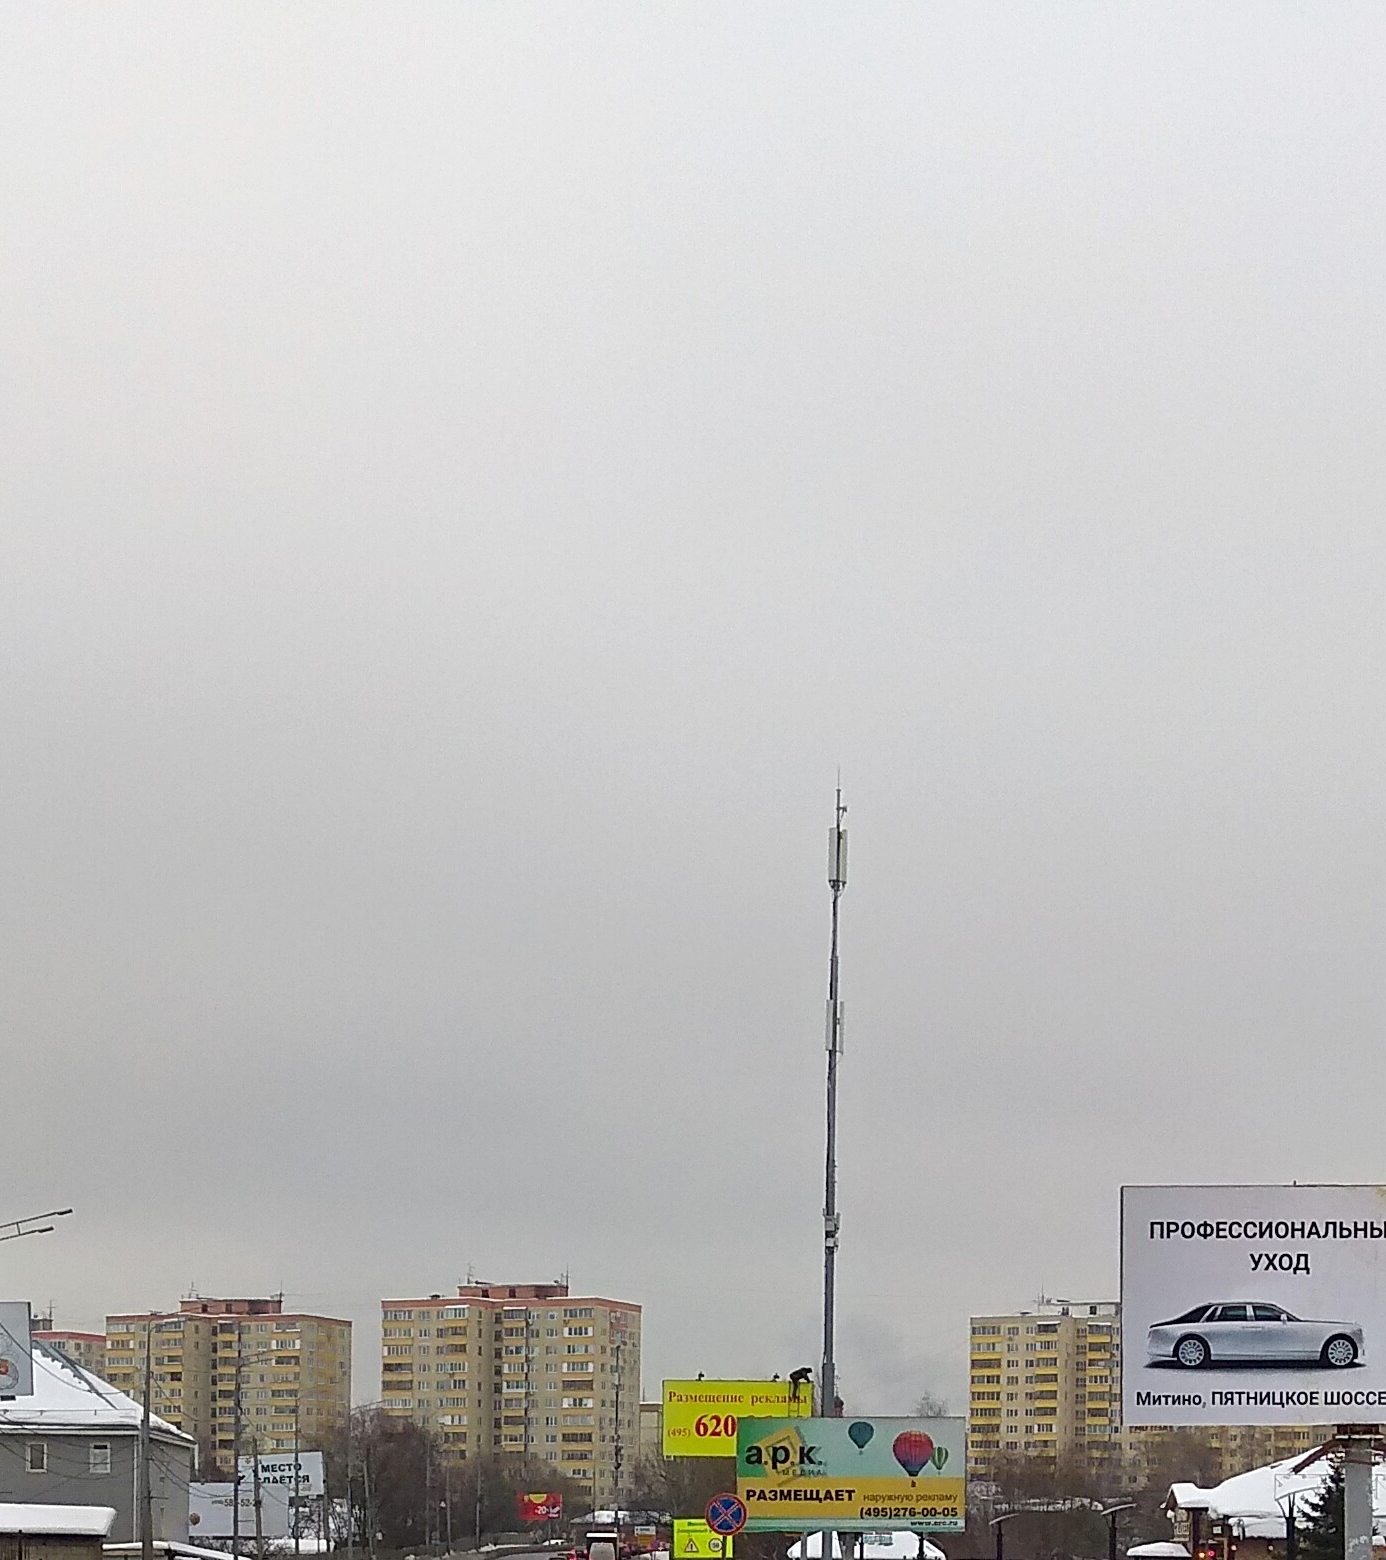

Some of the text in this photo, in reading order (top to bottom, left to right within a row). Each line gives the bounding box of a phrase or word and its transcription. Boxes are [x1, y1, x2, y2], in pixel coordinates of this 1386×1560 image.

[1249, 1253, 1311, 1275] УХОД
[668, 1391, 744, 1404] Размещение
[1135, 1391, 1207, 1408] Митино,
[1211, 1390, 1319, 1409] ПЯТНИЦКОЕ
[668, 1414, 737, 1438] (495) 620
[261, 1463, 302, 1473] МЕСТО
[746, 1489, 958, 1504] РАЗМЕЩАЕТ наружную рекламу
[860, 1507, 958, 1519] (495)276-00-05
